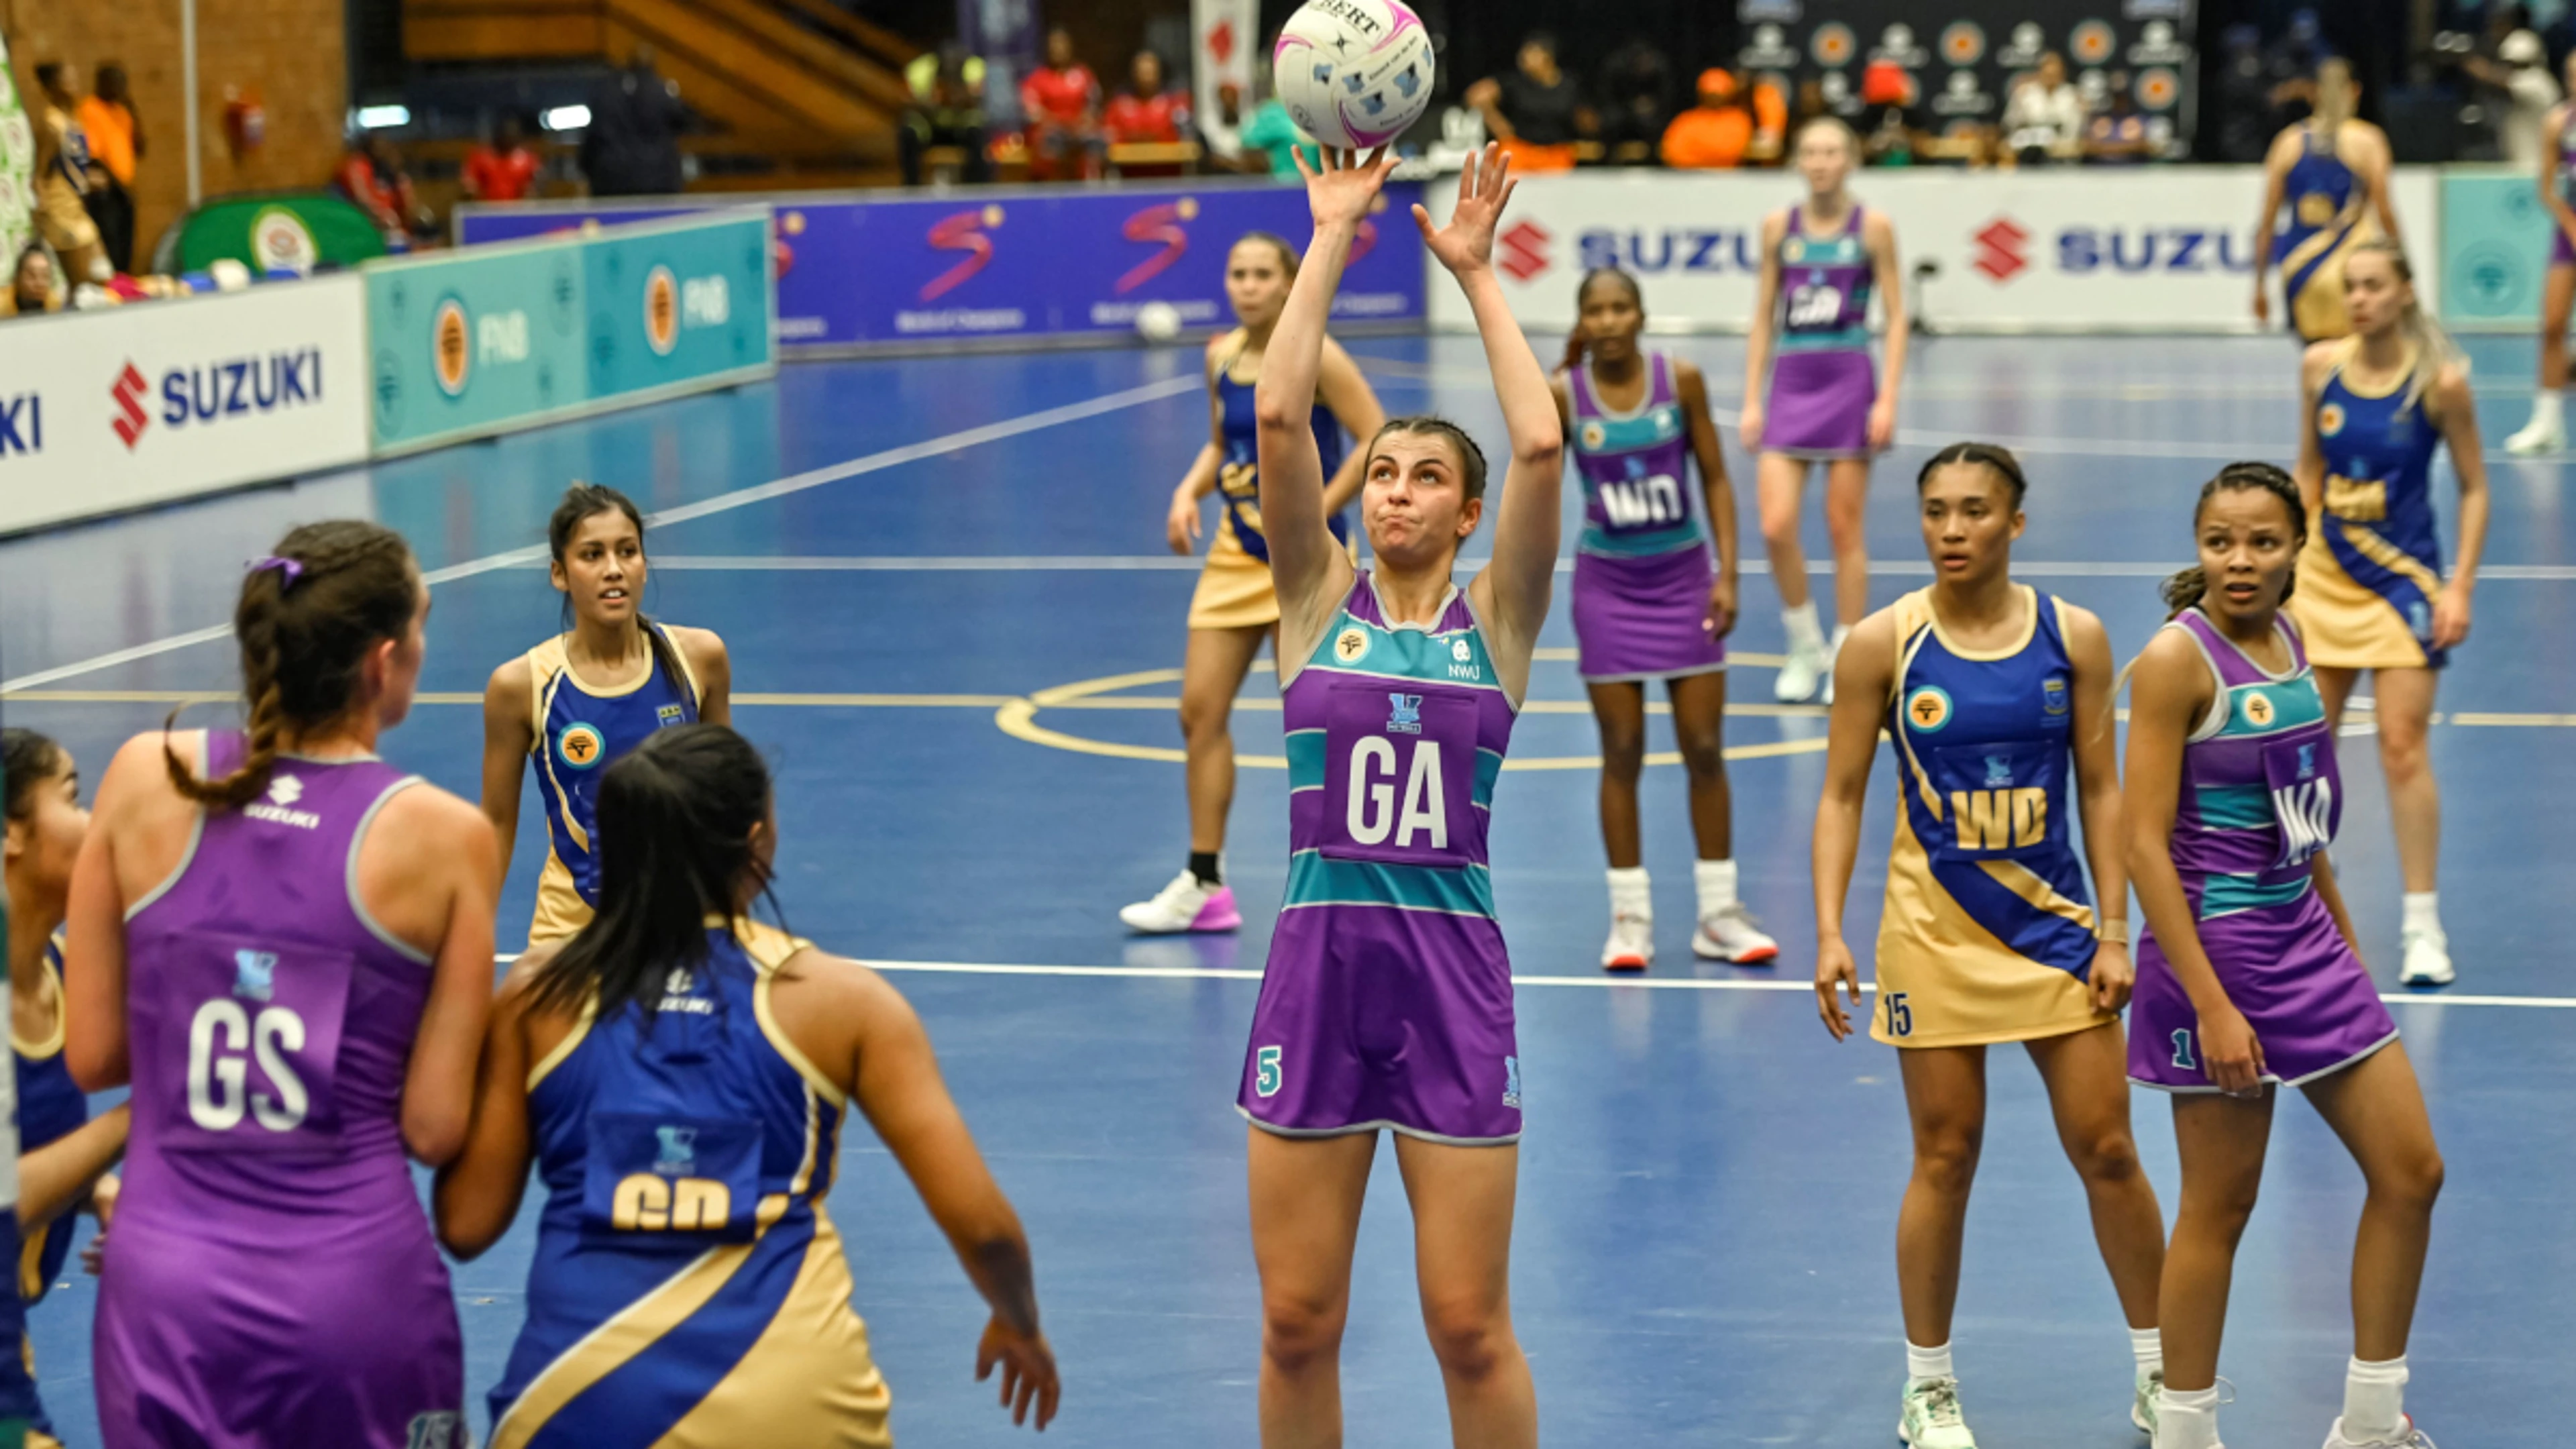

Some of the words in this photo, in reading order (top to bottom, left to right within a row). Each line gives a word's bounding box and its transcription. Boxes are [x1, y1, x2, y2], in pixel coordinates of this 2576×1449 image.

[162, 348, 322, 428] SUZUKI
[1448, 663, 1480, 680] NWU
[244, 804, 320, 829] SUZUKI
[1347, 736, 1448, 849] GA
[1950, 787, 2047, 849] WD
[657, 996, 712, 1015] UZUKI
[1884, 993, 1913, 1036] 15
[188, 998, 309, 1131] GS
[1256, 1046, 1282, 1097] 5
[2171, 1029, 2196, 1069] 1
[611, 1173, 731, 1230] GD
